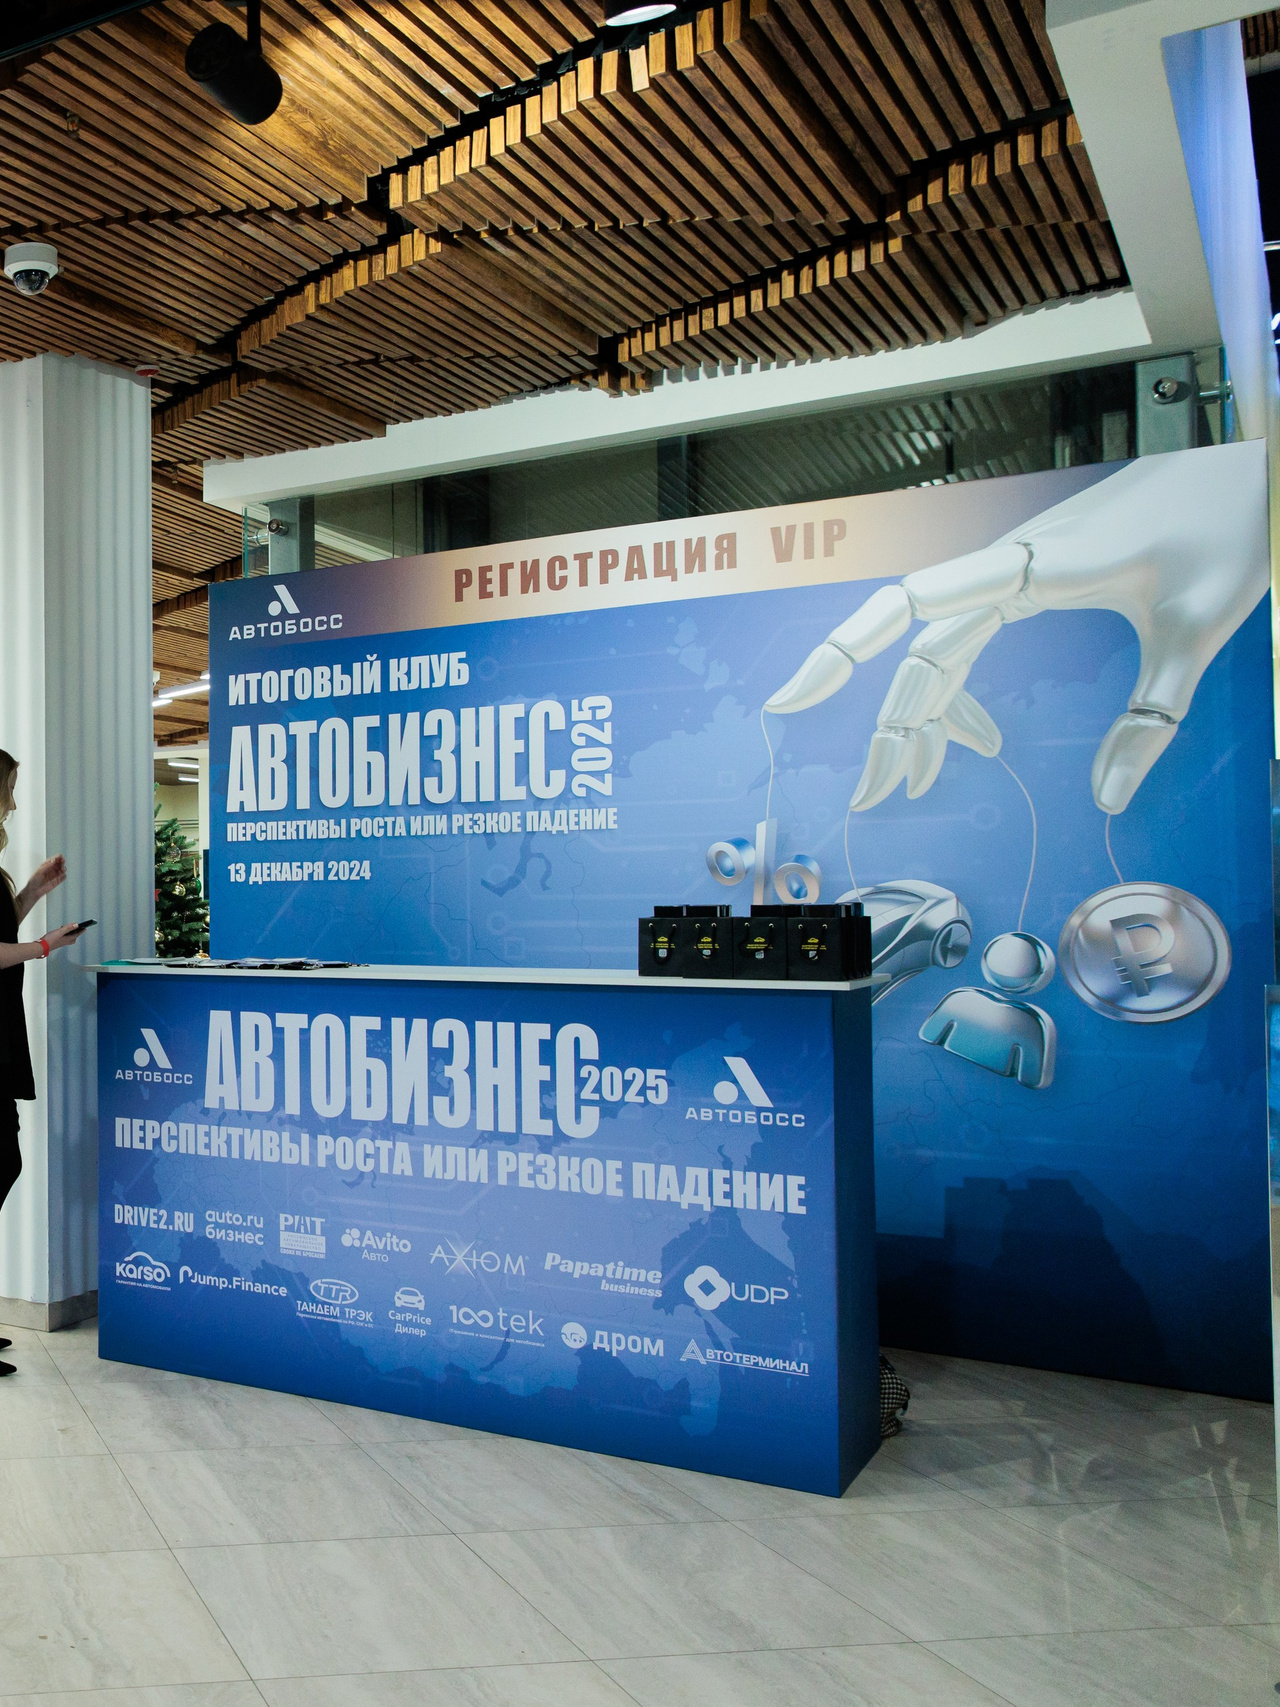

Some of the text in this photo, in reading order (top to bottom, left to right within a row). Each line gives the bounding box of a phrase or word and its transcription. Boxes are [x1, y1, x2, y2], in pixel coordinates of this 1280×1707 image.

[454, 518, 848, 602] РЕГИСТРАЦИЯ VIP
[228, 614, 343, 641] АВТОБОСС
[228, 650, 470, 706] ИТОГОВЫЙ КЛУБ
[226, 699, 567, 813] АВТОБИЗНЕС
[570, 695, 613, 798] 2025
[226, 808, 618, 842] ПЕРСПЕКТИВЫ РОСТА ИЛИ РЕЗКОЕ ПАДЕНИЕ
[228, 860, 372, 886] 13 ДЕКАБРЯ 2024
[115, 1069, 193, 1086] АВТОБОСС
[204, 1010, 600, 1138] АВТОБИЗНЕС
[580, 1066, 668, 1106] 2025
[685, 1107, 806, 1128] АВТОБОСС
[115, 1118, 807, 1216] ПЕРСПЕКТИВЫ РОСТА ИЛИ РЕЗКОЕ ПАДЕНИЕ
[114, 1204, 194, 1233] DRIVE2.RU
[205, 1210, 264, 1228] auto.ru
[205, 1224, 264, 1246] бизнес
[362, 1230, 412, 1253] Avito
[430, 1236, 526, 1279] AXIOM
[544, 1252, 662, 1284] Papatime
[190, 1272, 287, 1297] Jump.Finance
[601, 1280, 662, 1298] business
[730, 1281, 789, 1305] UDP
[297, 1300, 373, 1322] ТАНДЕМ ТРЭК
[388, 1310, 432, 1325] CarPrice
[395, 1324, 426, 1337] Дилер
